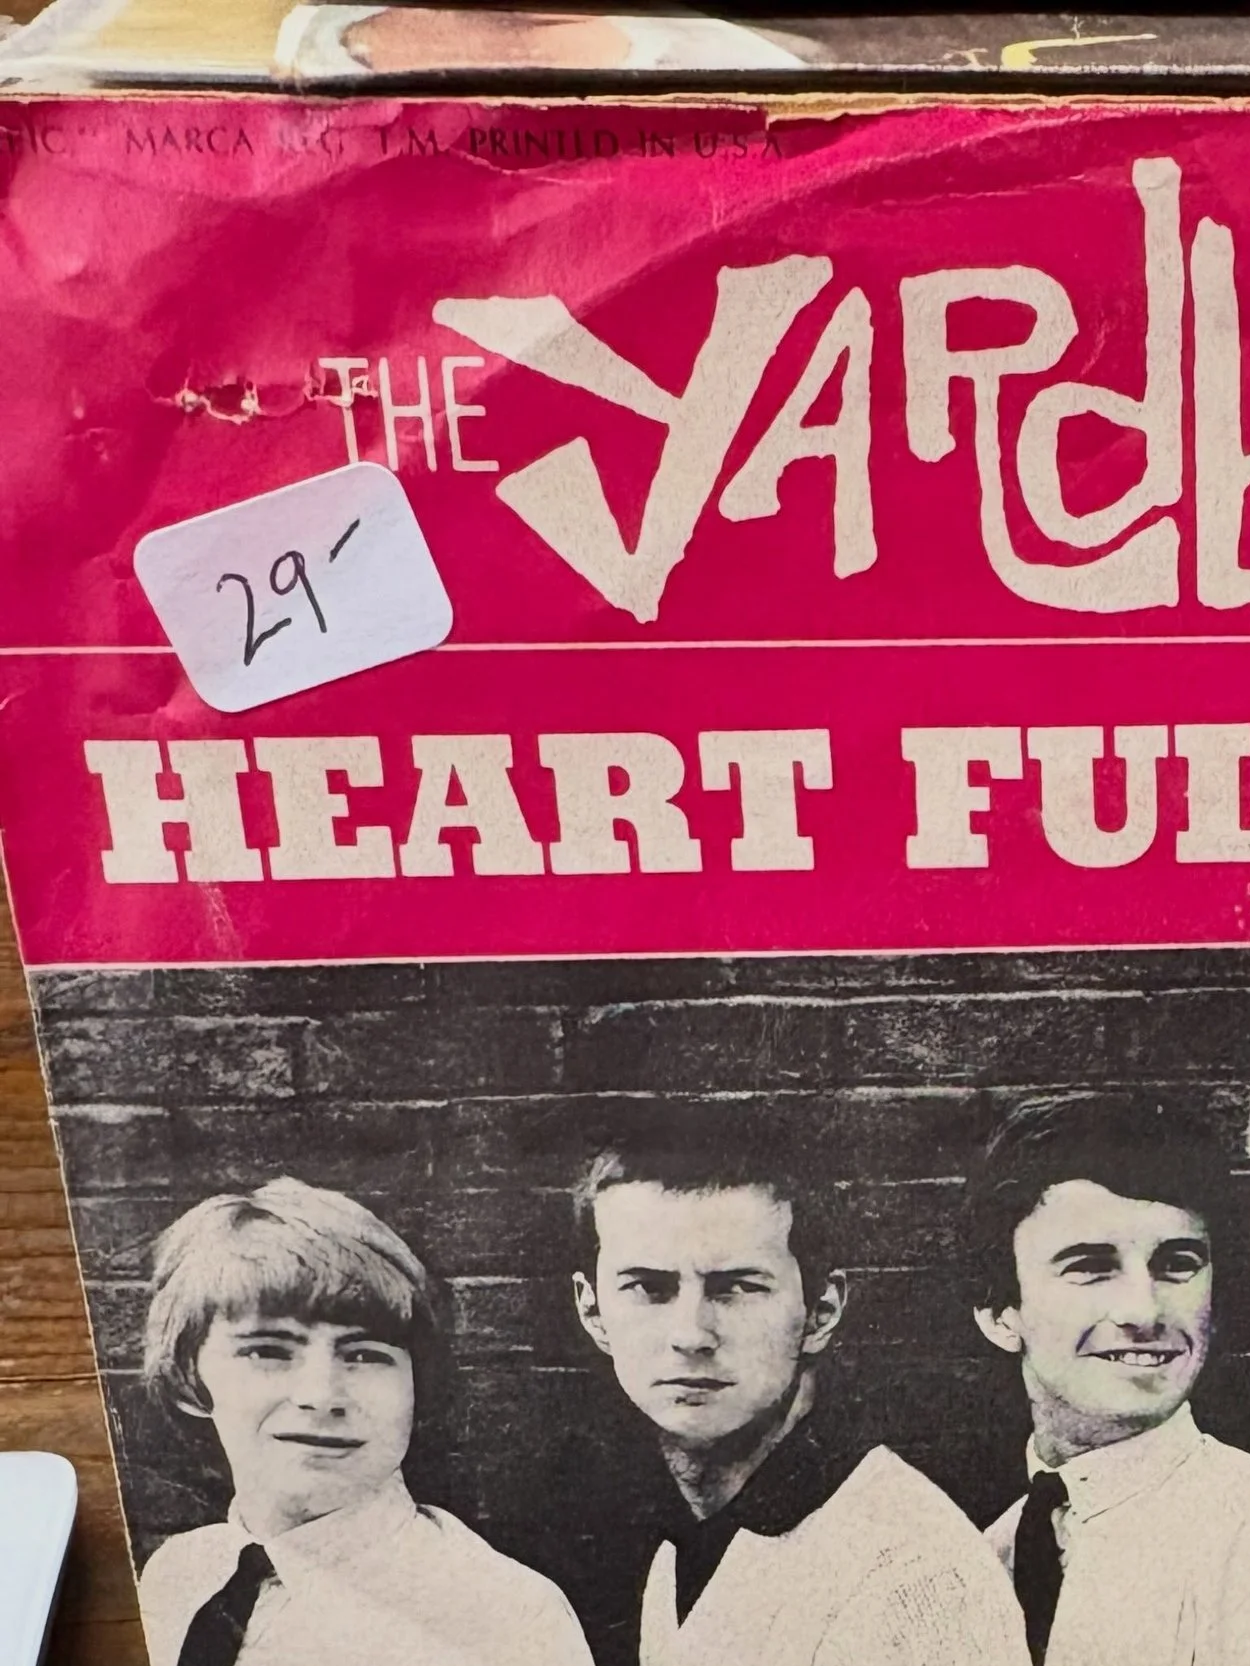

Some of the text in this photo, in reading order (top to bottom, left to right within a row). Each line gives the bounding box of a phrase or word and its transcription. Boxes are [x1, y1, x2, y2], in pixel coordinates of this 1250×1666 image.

[637, 129, 676, 158] IN
[319, 356, 500, 473] THE
[83, 728, 835, 885] HEART
